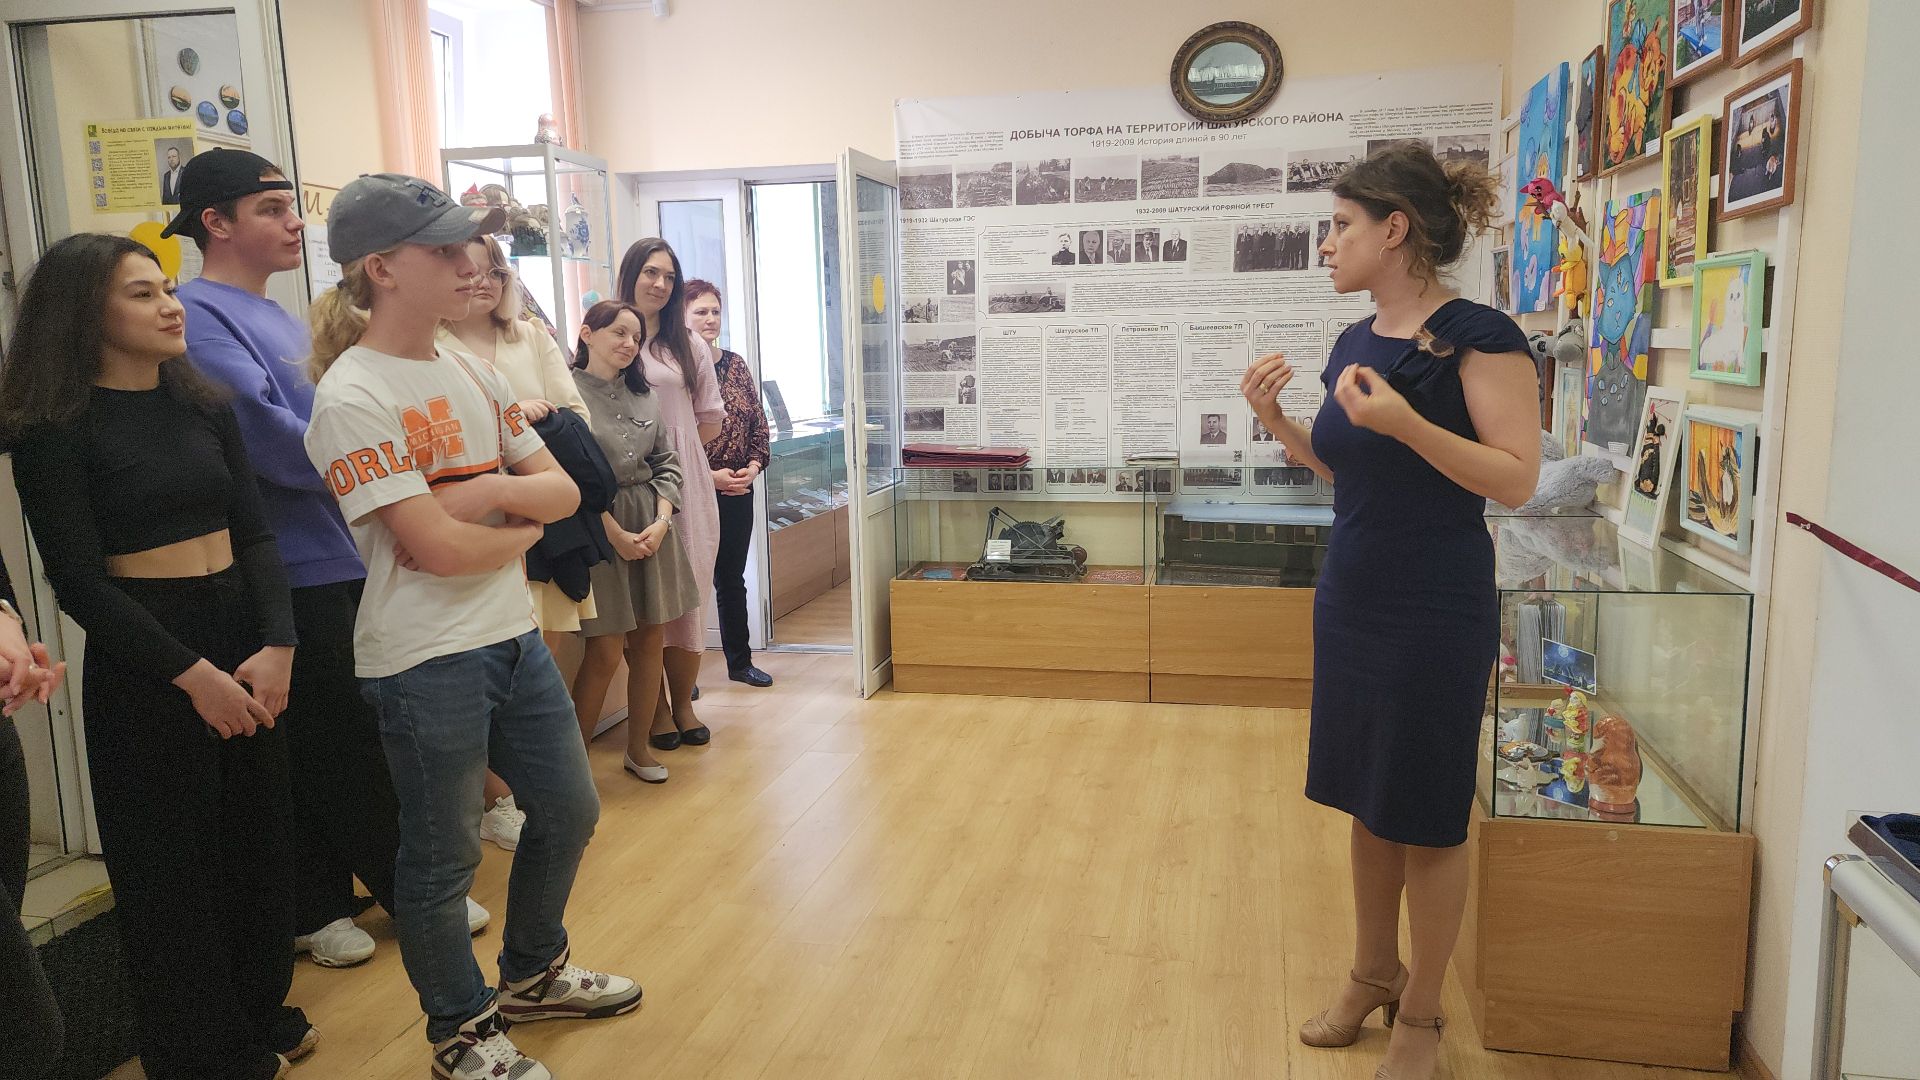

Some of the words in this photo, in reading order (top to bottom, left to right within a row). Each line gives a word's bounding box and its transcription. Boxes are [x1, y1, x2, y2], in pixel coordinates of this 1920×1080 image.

[1010, 128, 1061, 141] ДОБЫЧА
[1064, 126, 1103, 137] ТОРФА
[1106, 125, 1122, 134] НА
[1126, 120, 1204, 134] ТЕРРИТОРИИ
[1207, 115, 1290, 129] ШАТУРСКОГО
[1292, 111, 1344, 125] РАЙОНА
[1091, 138, 1135, 148] 1919-2009
[1137, 137, 1173, 146] История
[1176, 134, 1208, 144] длиной
[1218, 133, 1230, 141] 90
[1232, 133, 1247, 141] лет
[1168, 205, 1210, 213] ШАТУРСКИЙ
[1211, 202, 1250, 211] ТОРФЯНОЙ
[929, 216, 962, 224] Шатурская
[1055, 327, 1089, 335] Шатурское
